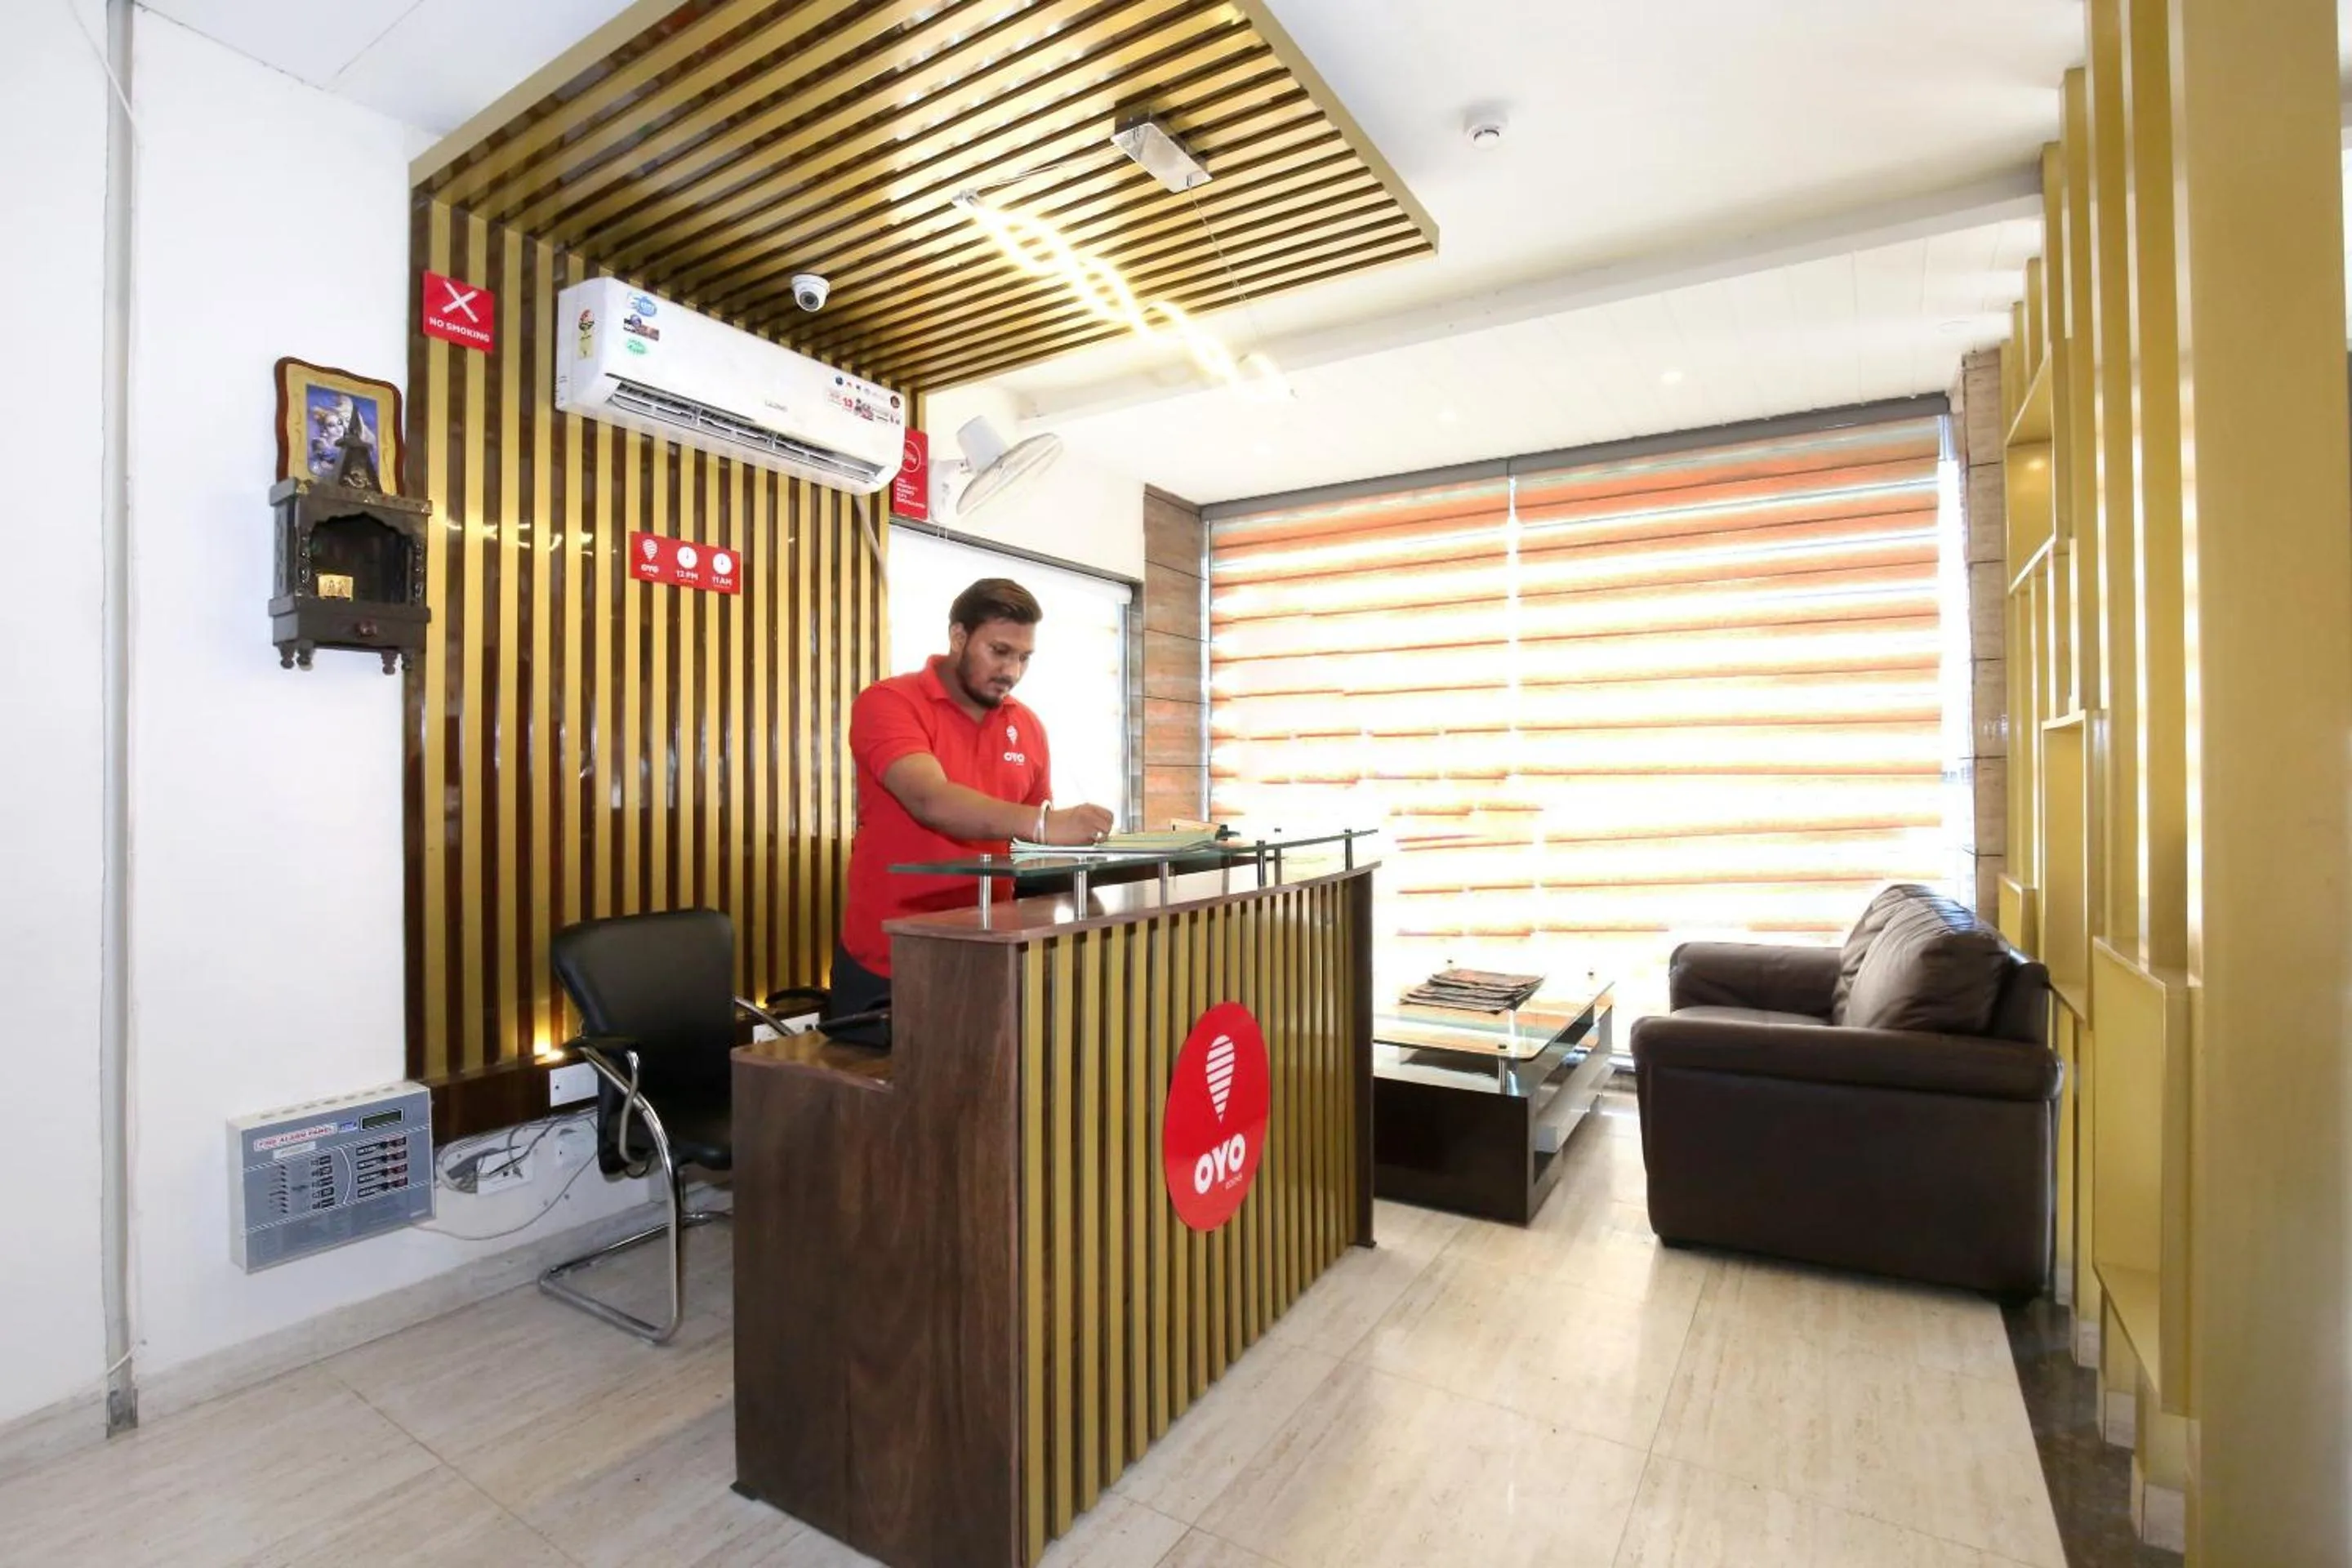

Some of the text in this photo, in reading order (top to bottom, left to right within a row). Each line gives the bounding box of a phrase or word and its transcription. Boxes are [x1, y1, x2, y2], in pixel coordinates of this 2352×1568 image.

[429, 317, 489, 343] NO SMOKING
[640, 564, 659, 573] OYO
[686, 572, 698, 581] PM
[719, 577, 732, 586] AM
[1004, 751, 1025, 763] OYO
[1194, 1133, 1245, 1195] OYO
